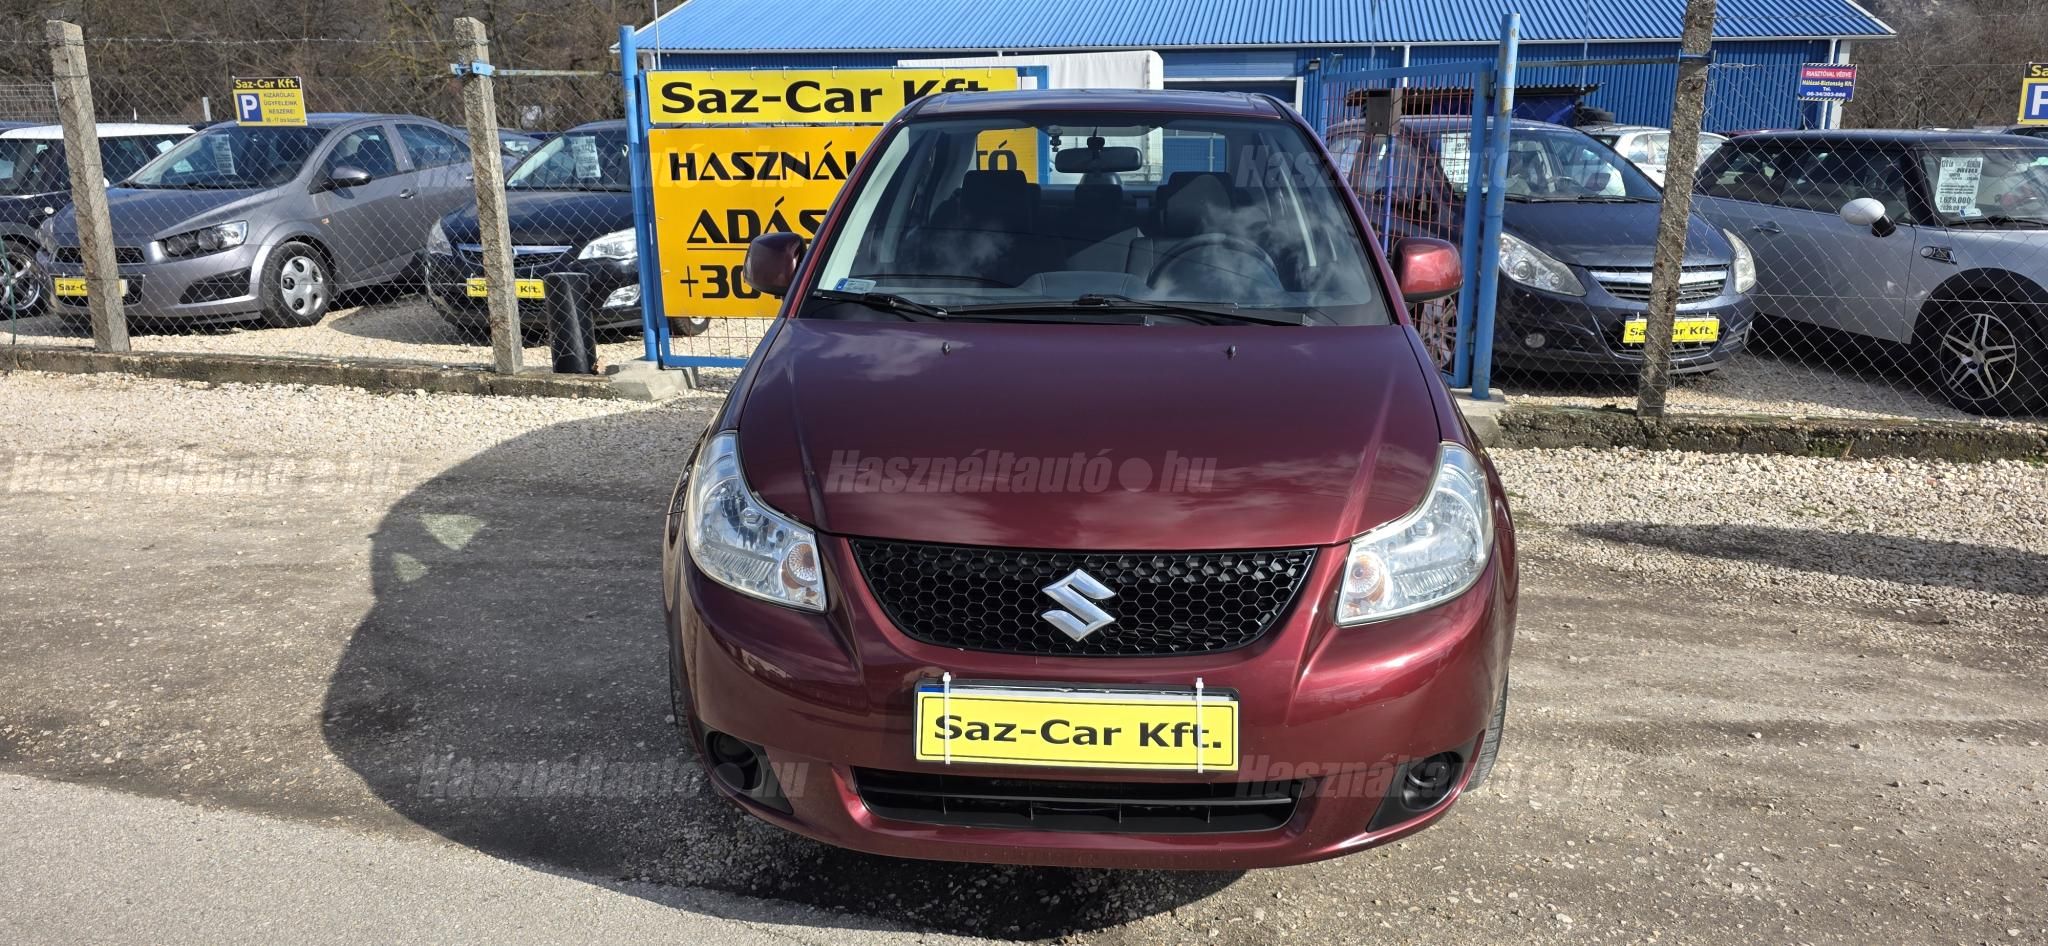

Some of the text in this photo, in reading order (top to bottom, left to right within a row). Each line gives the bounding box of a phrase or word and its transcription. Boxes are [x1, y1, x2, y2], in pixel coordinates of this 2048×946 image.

[235, 78, 298, 88] Saz-Car Kft.
[661, 80, 884, 114] Saz-Car
[934, 714, 1223, 750] Saz-Car Kft.
